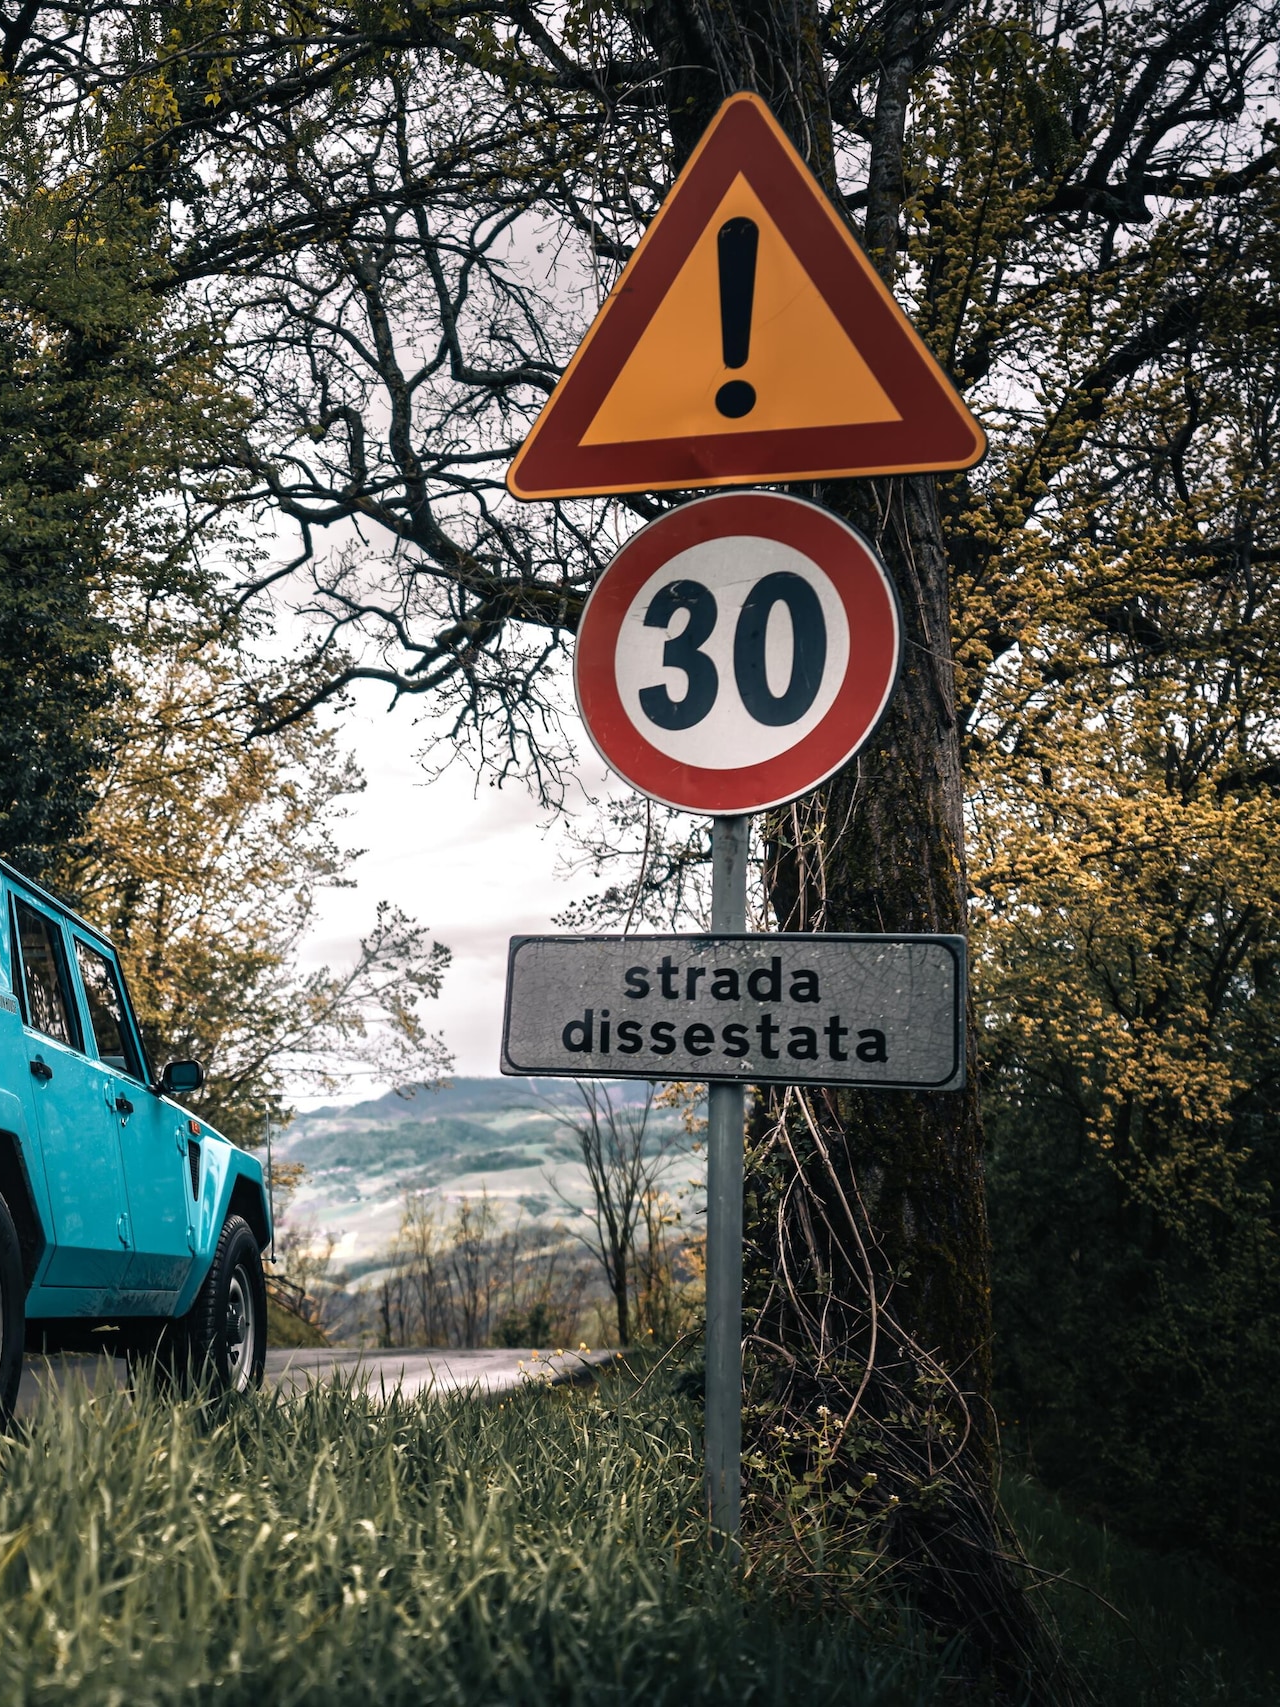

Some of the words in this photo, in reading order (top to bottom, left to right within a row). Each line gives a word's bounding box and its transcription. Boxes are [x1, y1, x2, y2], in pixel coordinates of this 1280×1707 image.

[638, 570, 827, 731] 30
[624, 956, 822, 1004] strada
[562, 1009, 889, 1064] dissestata
